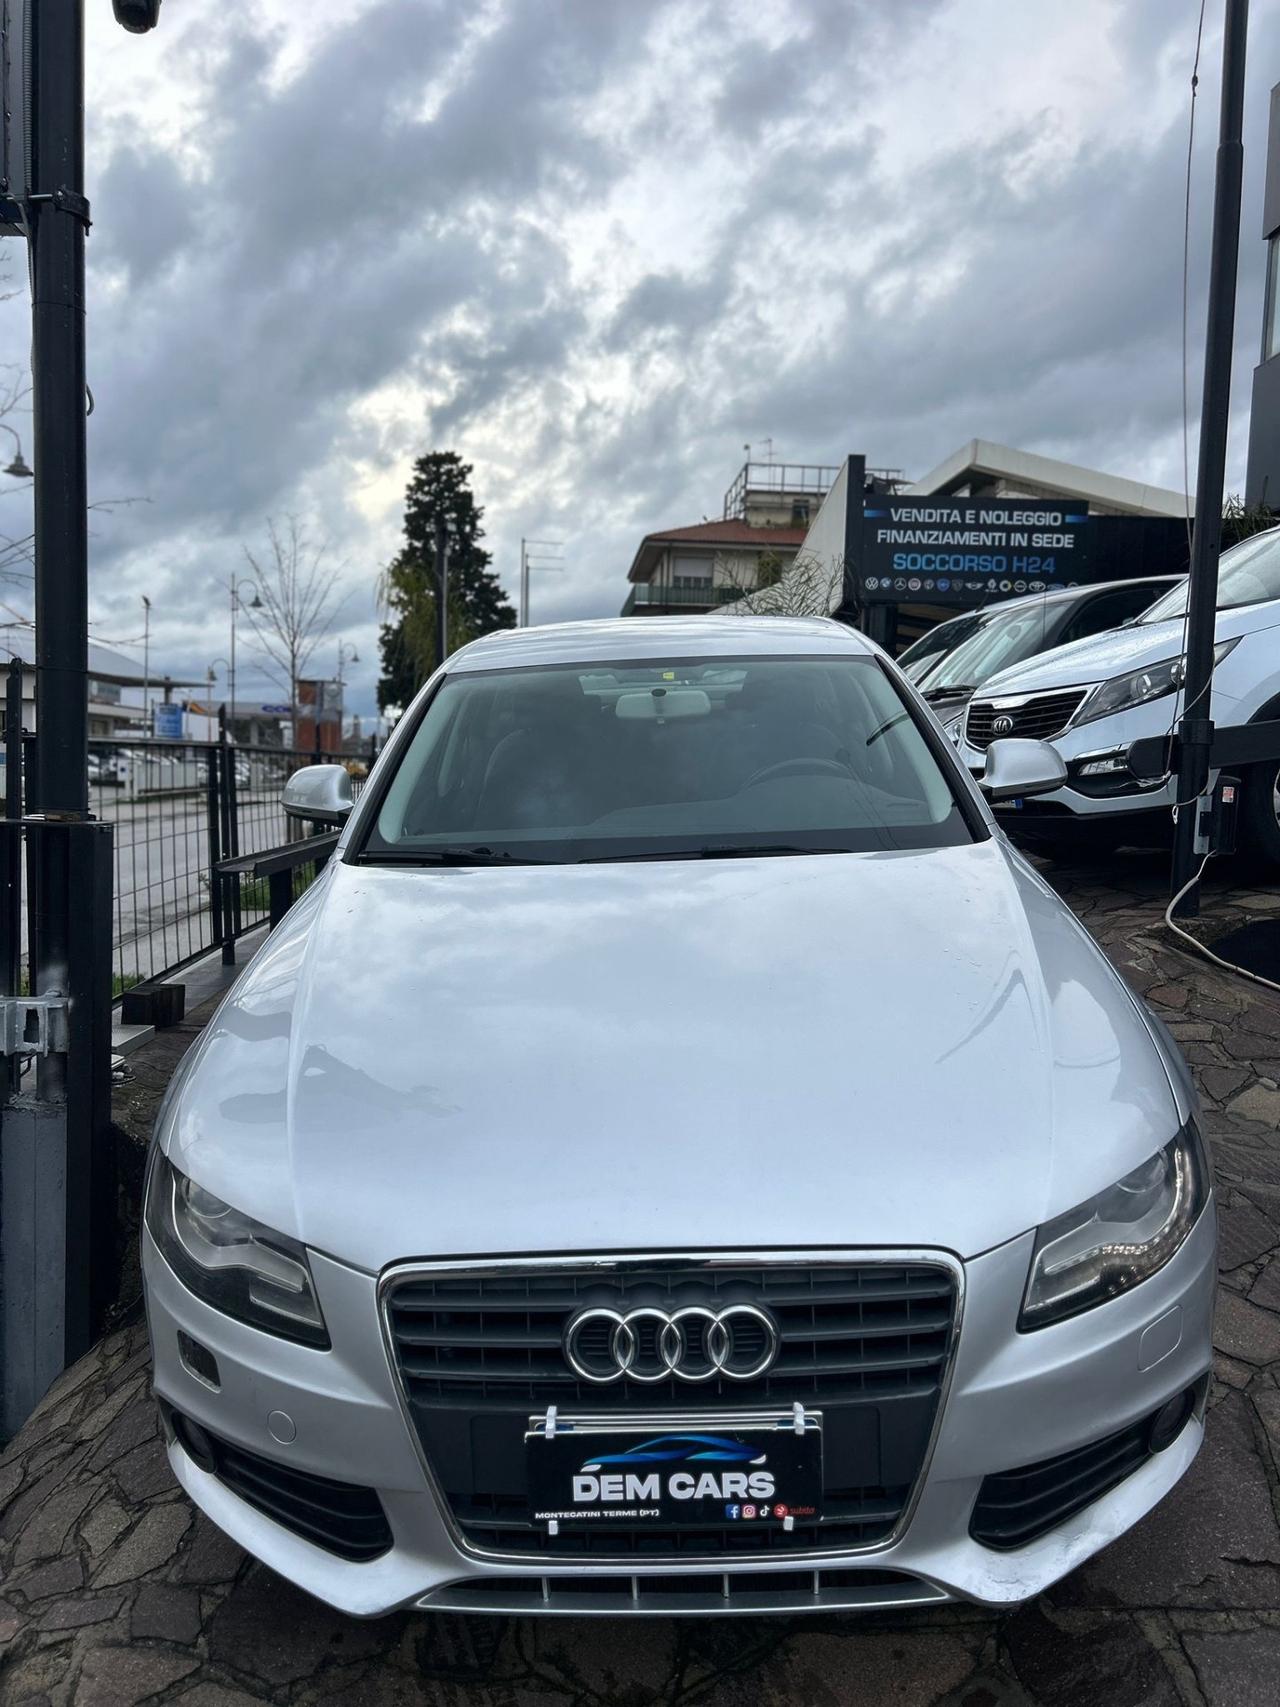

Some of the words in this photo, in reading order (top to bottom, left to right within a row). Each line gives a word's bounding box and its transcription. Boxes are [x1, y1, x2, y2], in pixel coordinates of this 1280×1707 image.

[890, 508, 961, 523] VENDITA
[965, 510, 975, 523] E
[980, 510, 1062, 526] NOLEGGIO
[877, 529, 1006, 546] FINANZIAMENTI
[1010, 533, 1028, 547] IN
[1032, 533, 1074, 548] SEDE
[893, 553, 1007, 572] SOCCORSO
[1012, 556, 1055, 573] H24
[572, 1474, 660, 1502] DEM
[668, 1471, 775, 1500] CARS
[535, 1511, 600, 1519] MONTECATINI
[639, 1509, 660, 1517] (PT)
